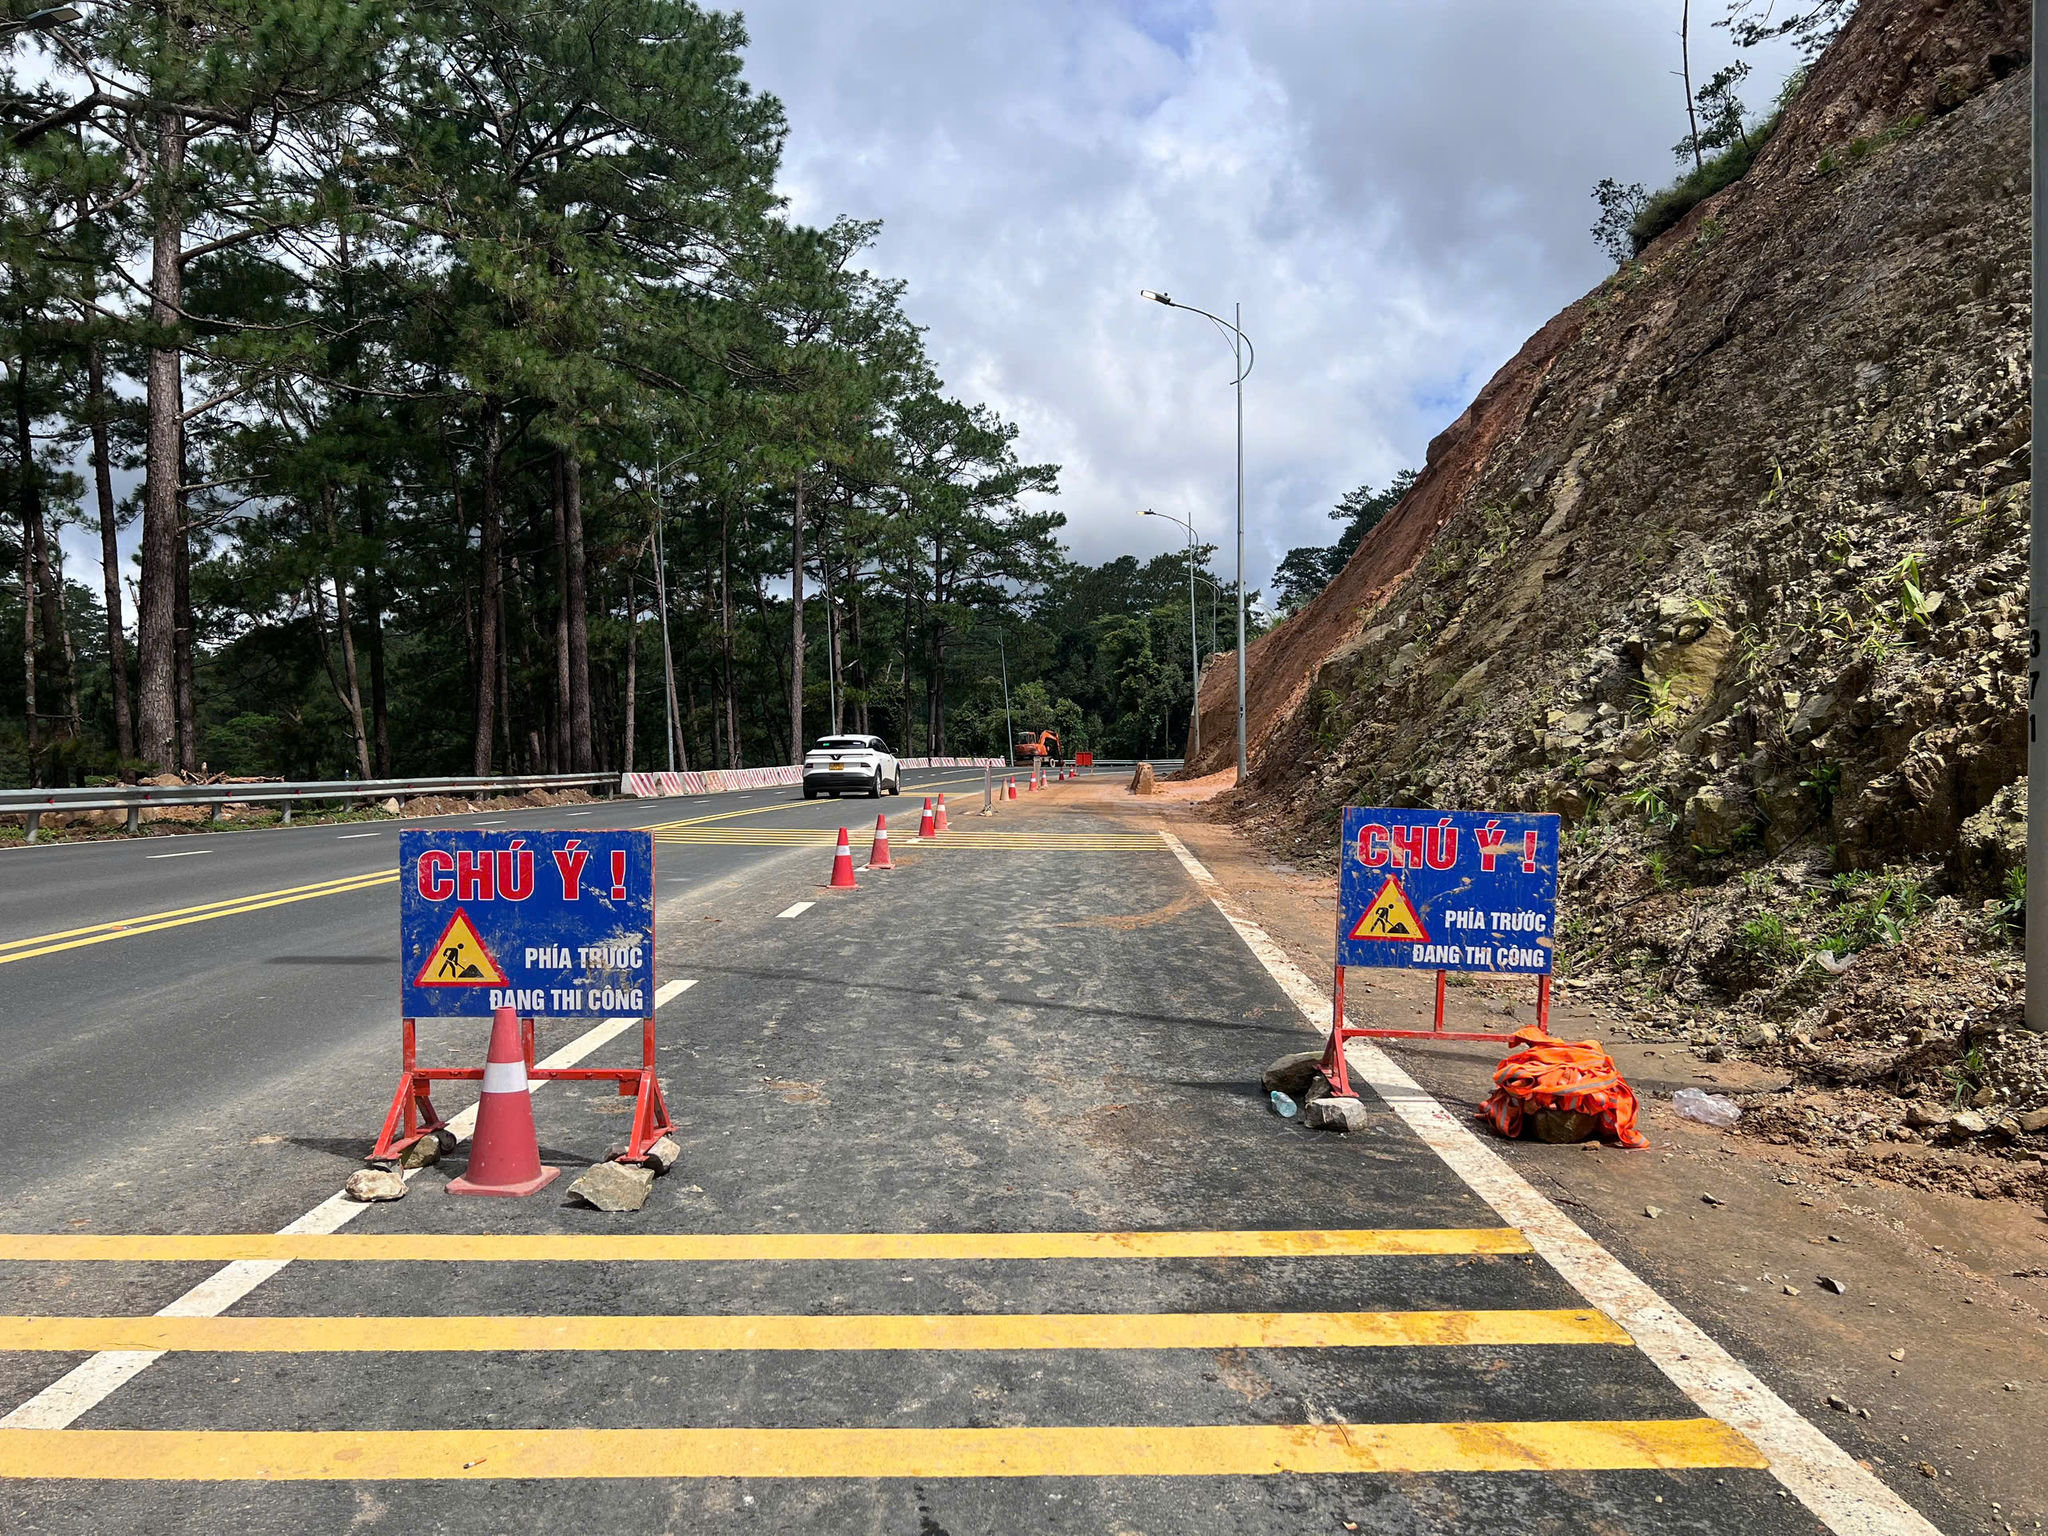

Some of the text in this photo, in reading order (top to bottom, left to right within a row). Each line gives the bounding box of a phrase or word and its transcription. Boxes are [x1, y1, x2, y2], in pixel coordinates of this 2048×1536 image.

[1357, 818, 1538, 874] CHÚ Ý !
[417, 839, 626, 902] CHÚ Ý !
[1444, 907, 1547, 933] PHÍA TRƯỚC
[525, 943, 572, 969] PHÍA
[1412, 944, 1545, 968] ĐANG THI CÔNG
[489, 984, 644, 1011] ĐANG THI CÔNG
